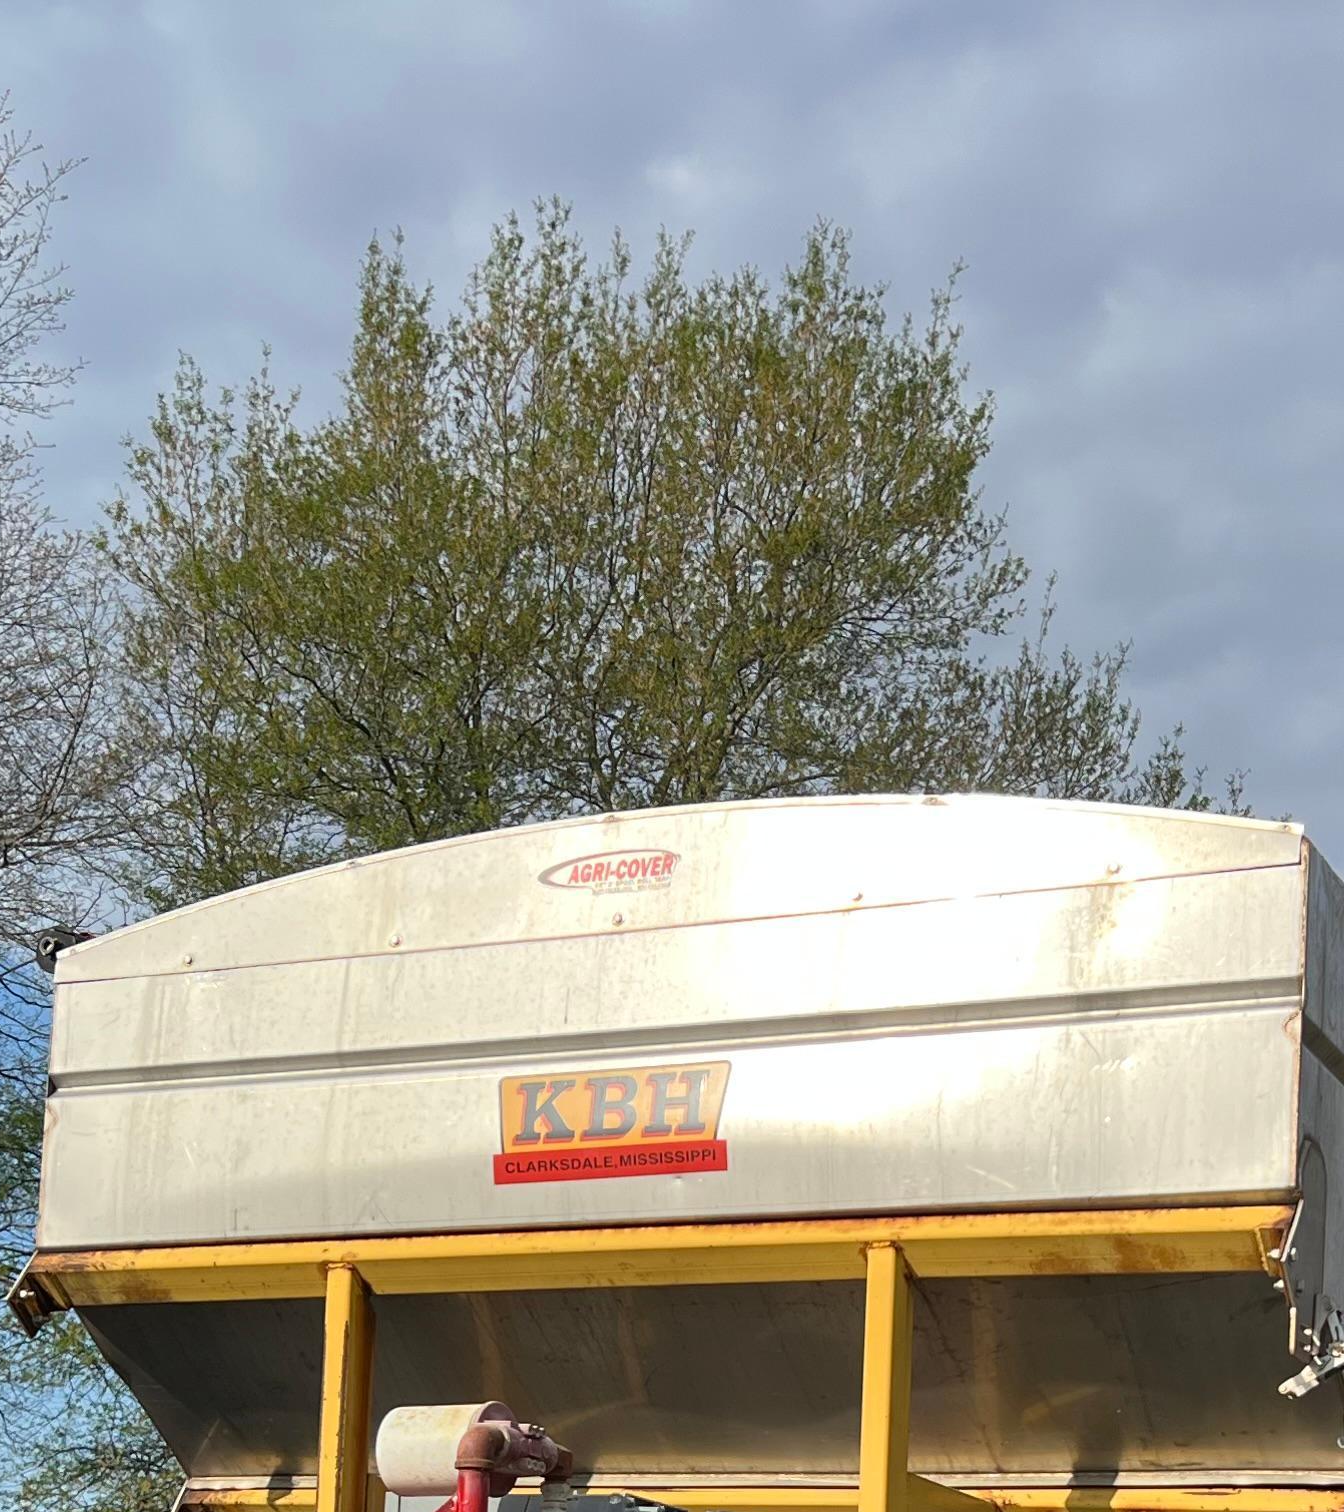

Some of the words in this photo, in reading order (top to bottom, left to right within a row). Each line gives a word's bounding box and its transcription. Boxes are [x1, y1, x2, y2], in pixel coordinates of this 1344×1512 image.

[568, 853, 673, 884] AGRI-COVER
[512, 1070, 710, 1146] KBH
[505, 1156, 618, 1174] CLARKSDALE,
[619, 1148, 716, 1168] MISSISSIPPI
